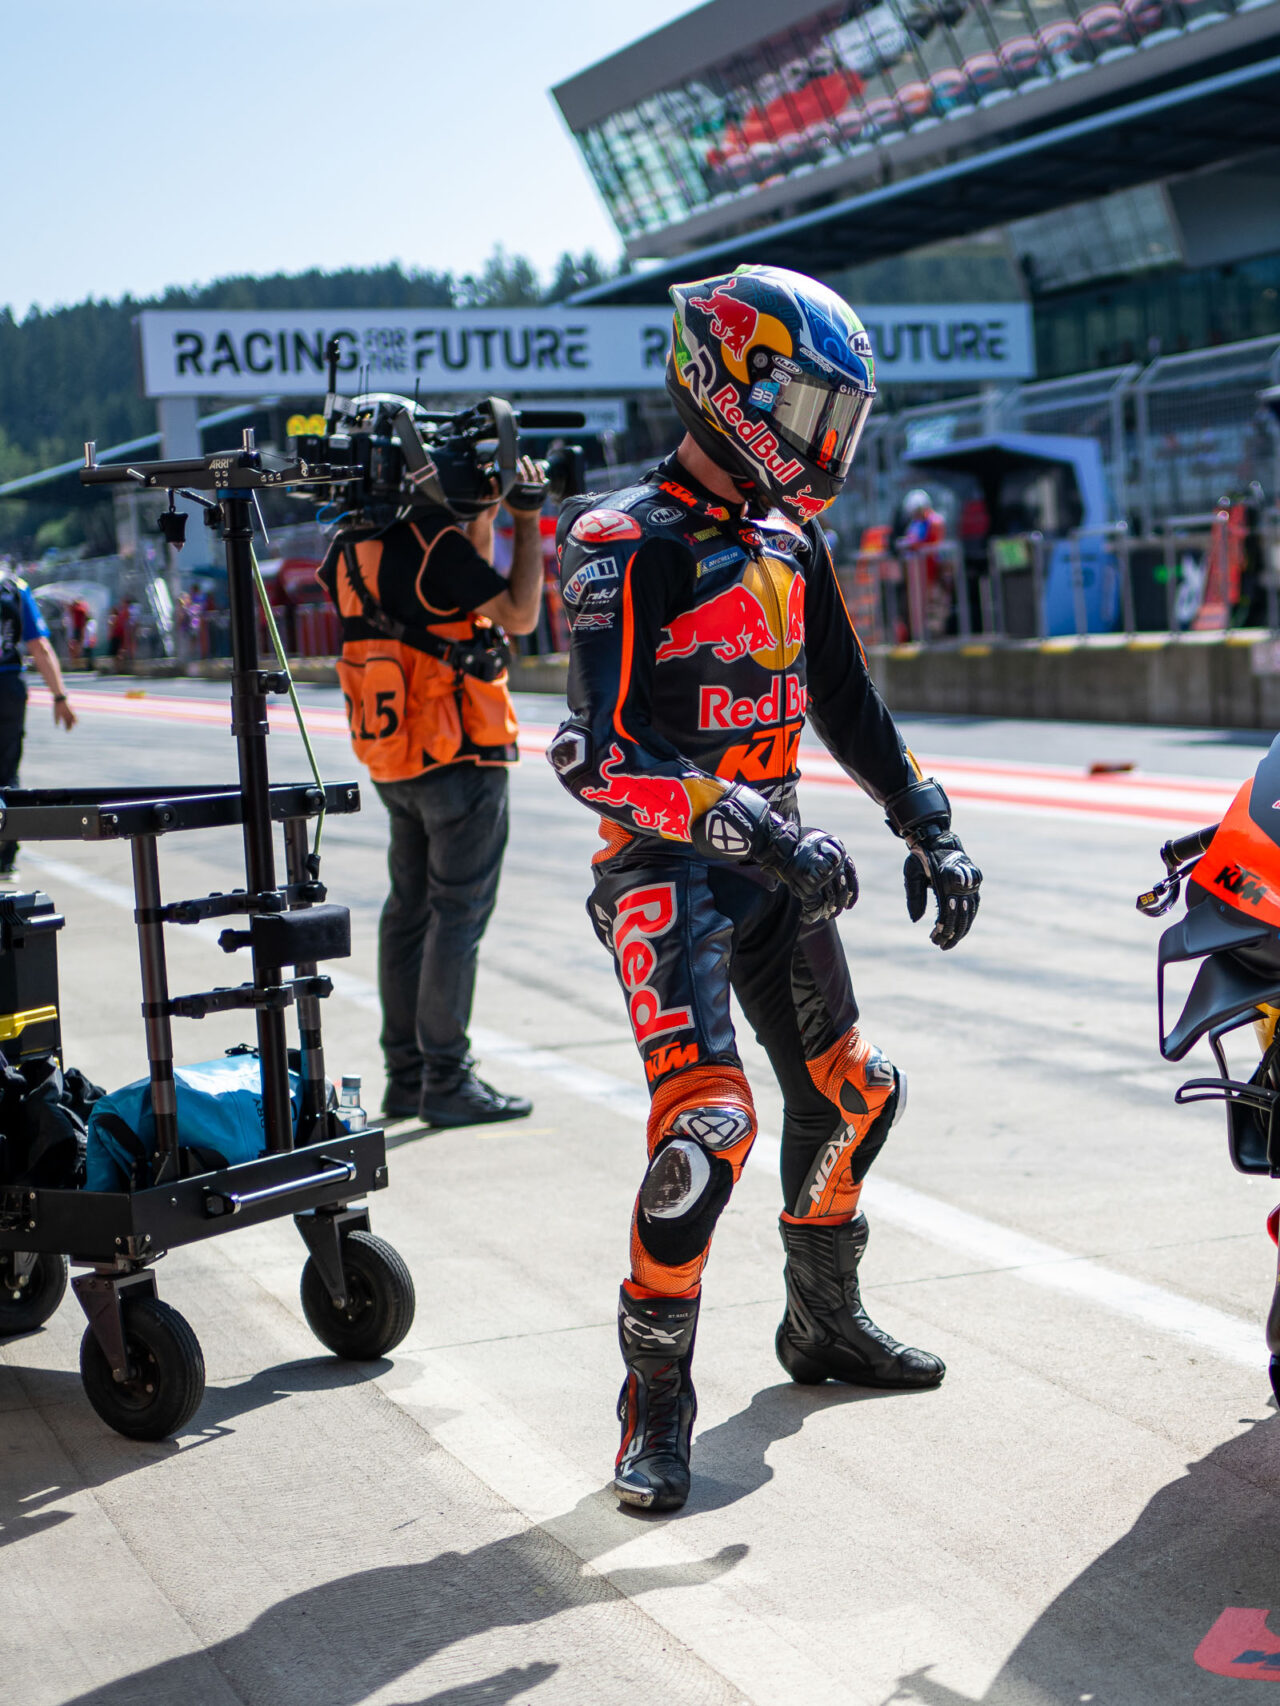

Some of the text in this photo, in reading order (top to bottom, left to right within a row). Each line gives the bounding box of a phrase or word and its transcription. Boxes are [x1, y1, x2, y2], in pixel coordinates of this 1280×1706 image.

[174, 329, 359, 376] RACING
[363, 327, 408, 349] FOR
[411, 326, 590, 374] FUTURE
[863, 321, 1008, 363] UTURE
[752, 387, 774, 404] 33
[713, 384, 805, 484] Red Bull
[209, 458, 229, 470] ARRI
[658, 481, 698, 508] KTM
[564, 563, 596, 603] Mobil
[573, 612, 616, 627] CX
[698, 673, 783, 731] Red
[1140, 892, 1156, 905] 33
[1214, 865, 1268, 907] KTM
[612, 881, 696, 1049] Red
[646, 1041, 699, 1083] KTM
